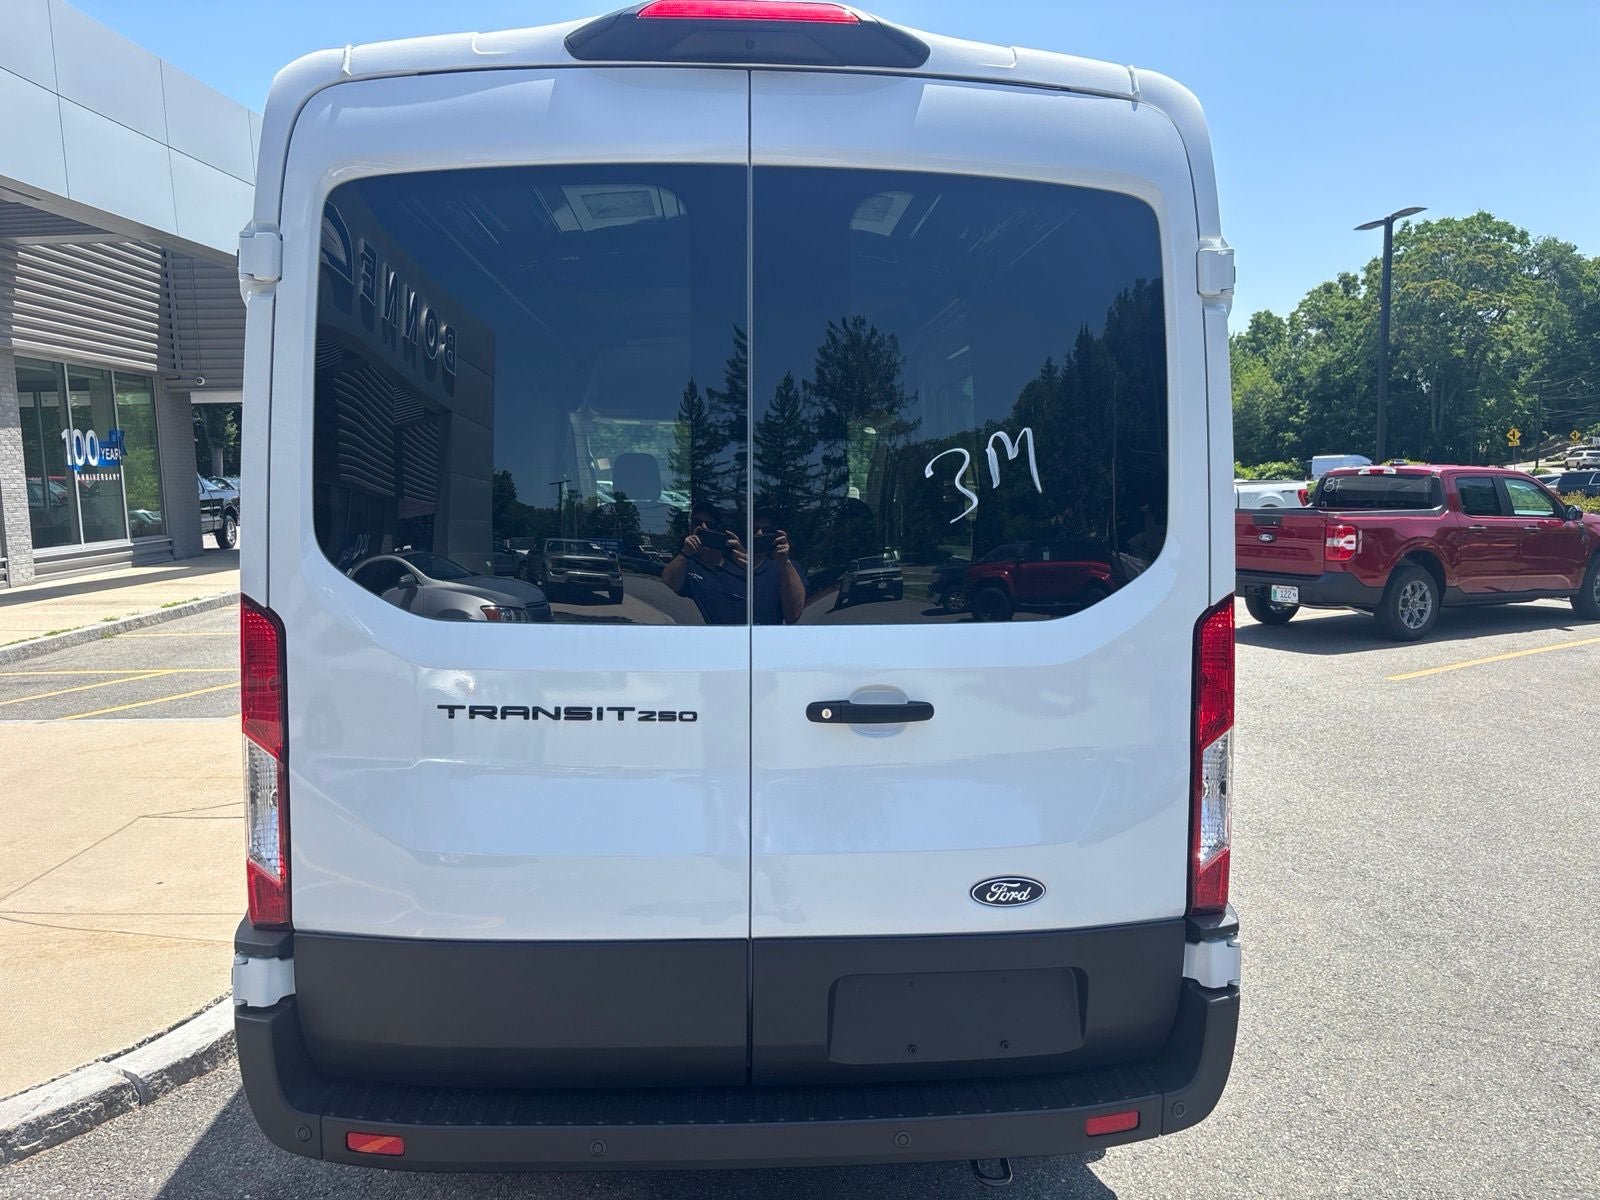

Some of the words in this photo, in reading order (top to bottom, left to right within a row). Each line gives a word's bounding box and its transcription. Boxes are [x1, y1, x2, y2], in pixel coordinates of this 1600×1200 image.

[61, 428, 100, 467] 100
[437, 704, 636, 722] TRANSIT
[637, 710, 698, 722] 250
[985, 882, 1032, 902] Ford
